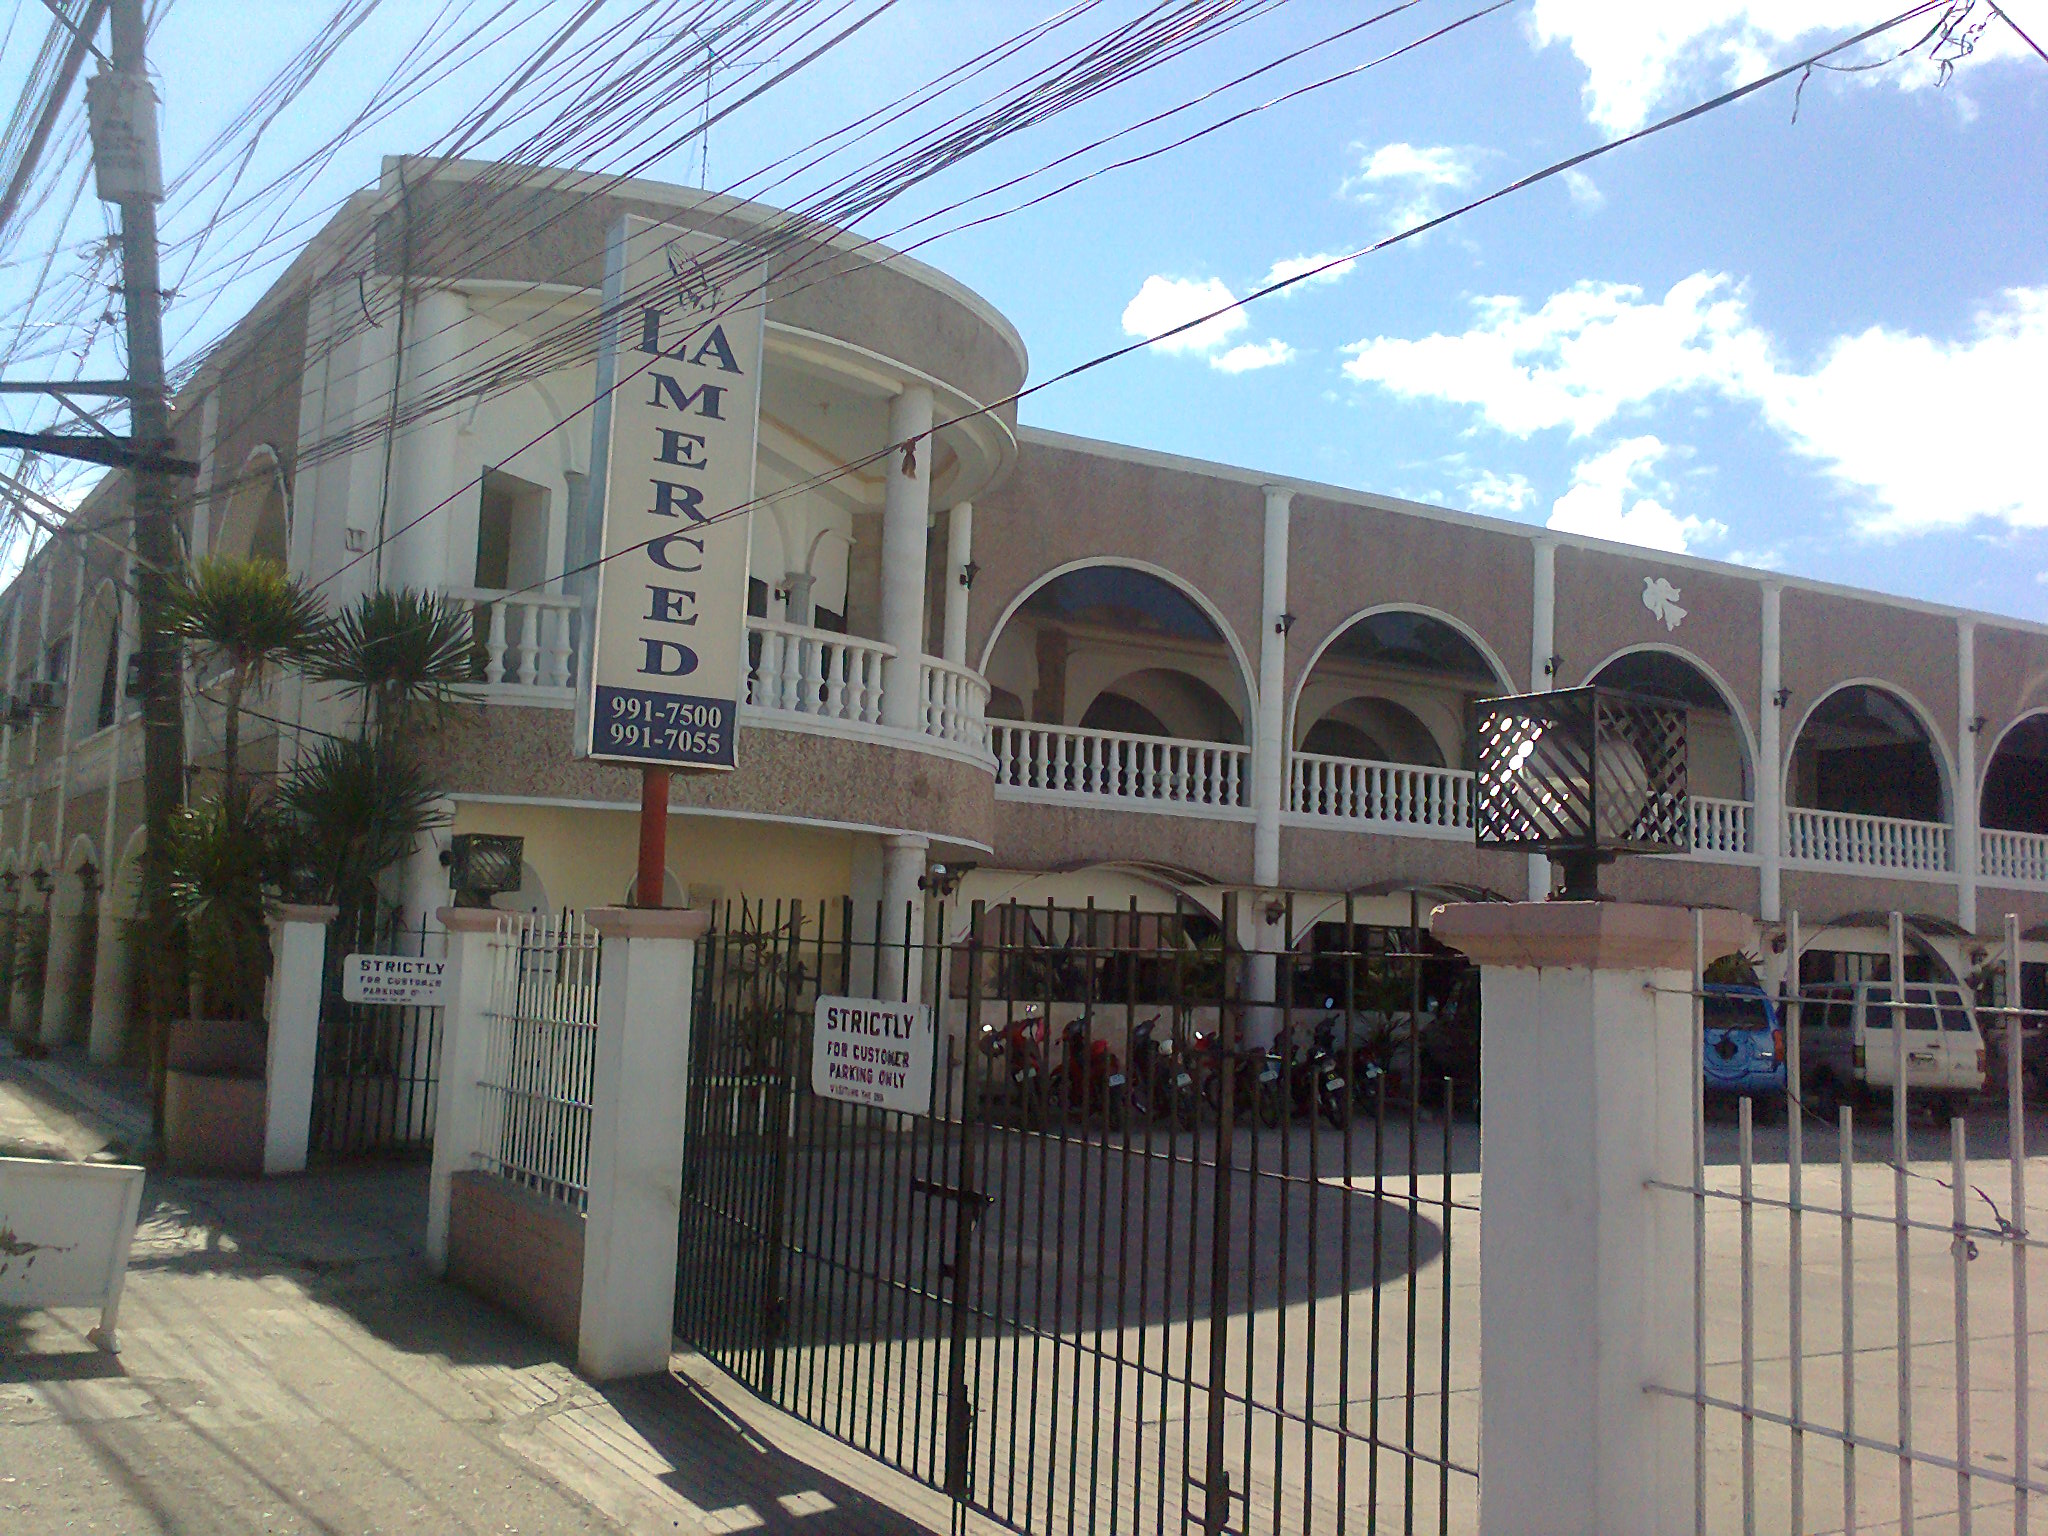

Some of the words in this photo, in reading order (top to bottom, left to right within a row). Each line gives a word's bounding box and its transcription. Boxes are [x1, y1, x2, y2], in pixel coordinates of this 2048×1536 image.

[636, 307, 744, 375] LA
[637, 371, 729, 677] MERCED
[610, 696, 722, 729] 991-7500
[609, 722, 721, 755] 991-7055
[360, 959, 446, 975] STRICTLY
[360, 975, 381, 985] FOR
[827, 1006, 914, 1040] STRICTLY
[827, 1040, 849, 1058] FOR
[852, 1044, 910, 1069] CUSTOMER
[829, 1062, 874, 1085] PARKING
[878, 1069, 907, 1090] ONLY
